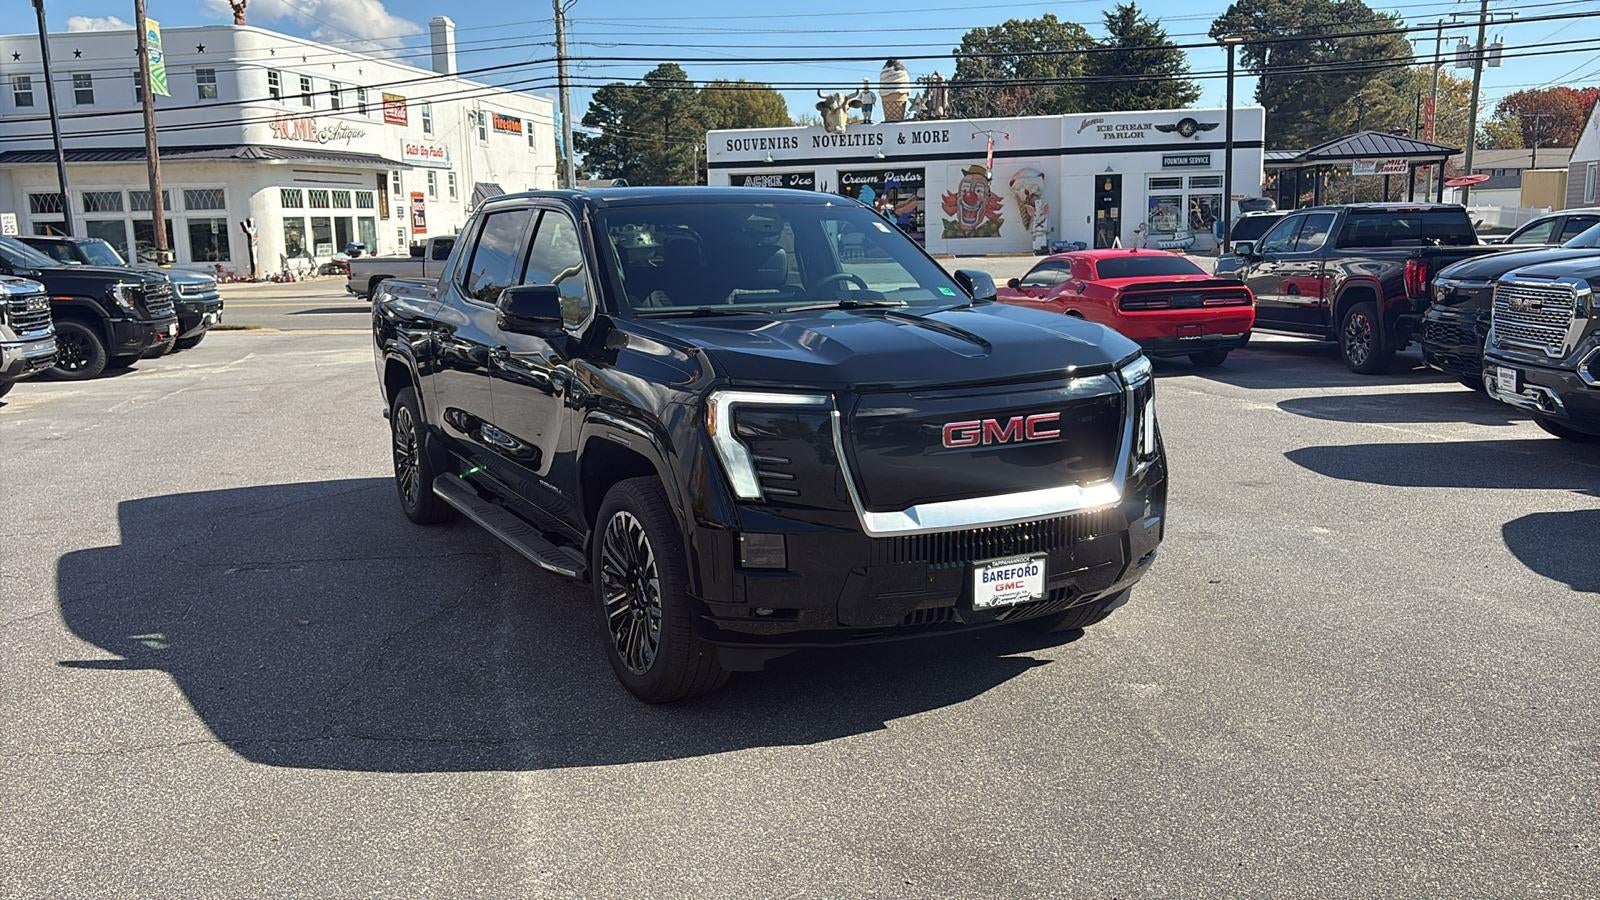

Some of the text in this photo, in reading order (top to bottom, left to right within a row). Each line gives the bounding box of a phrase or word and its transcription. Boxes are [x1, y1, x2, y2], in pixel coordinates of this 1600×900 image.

[268, 112, 318, 143] ACME
[1115, 123, 1152, 132] CREAM
[726, 130, 949, 151] SOUVENIRS NOVELTIES & MORE
[1104, 131, 1145, 139] PARLOR
[1164, 156, 1209, 165] FOUNTAIN SERVICE
[744, 174, 813, 187] ACME Ice
[842, 171, 922, 184] Cream Parlor
[4, 225, 16, 234] 25
[942, 411, 1061, 448] GMC
[982, 565, 1039, 584] BAREFORD
[995, 580, 1025, 592] GMC
